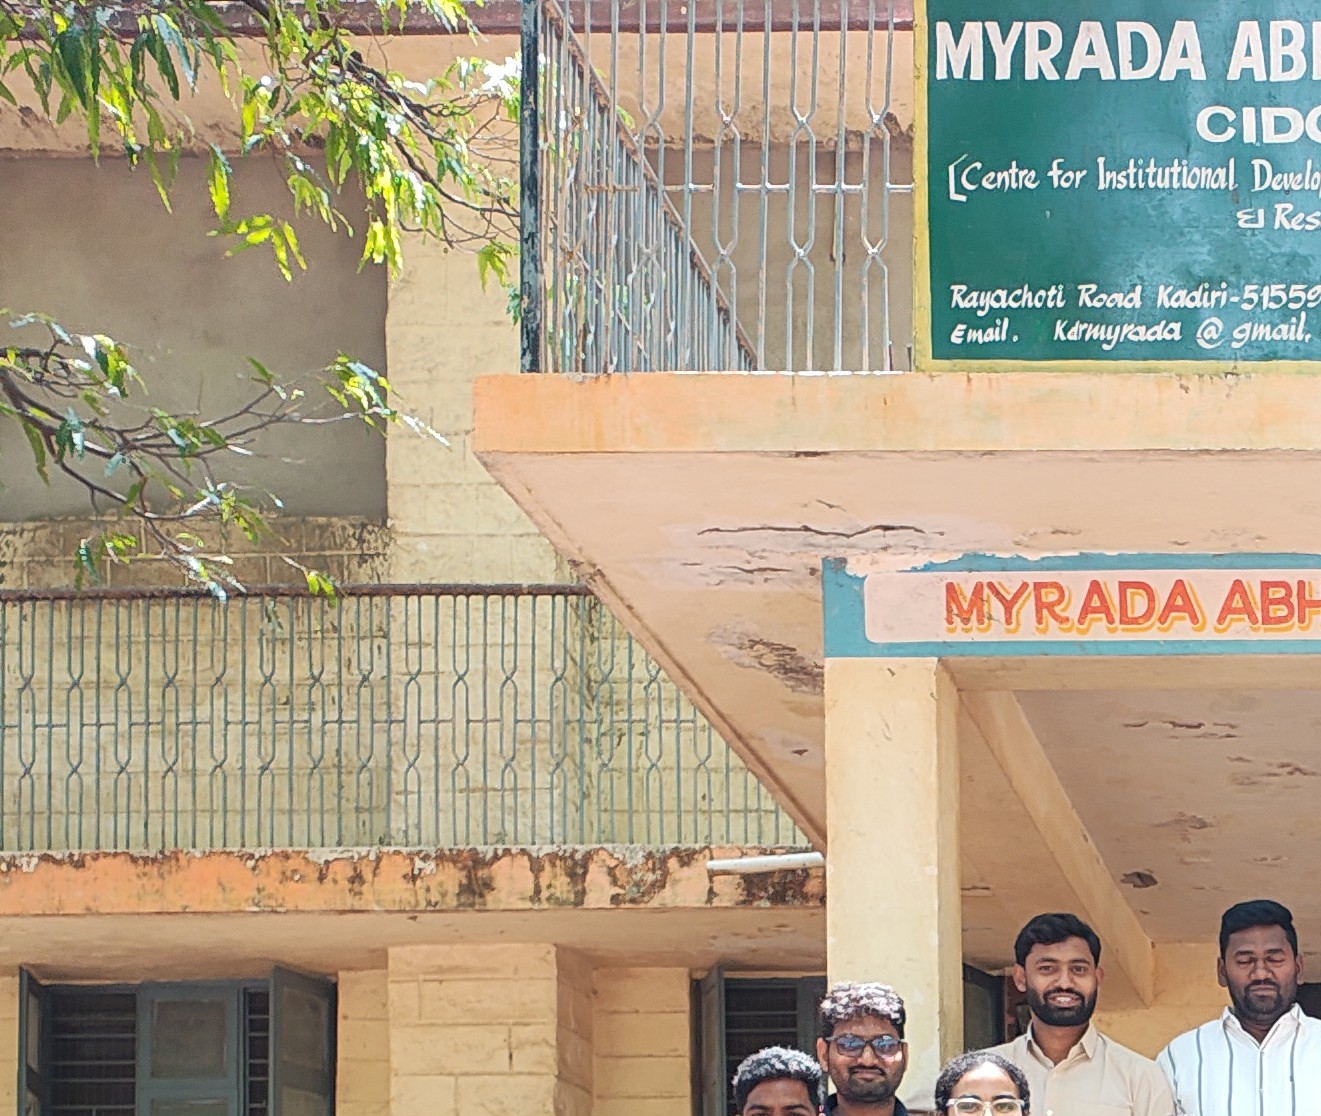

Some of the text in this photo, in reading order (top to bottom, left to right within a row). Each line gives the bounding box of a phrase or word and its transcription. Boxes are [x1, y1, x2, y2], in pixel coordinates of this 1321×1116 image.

[935, 20, 1207, 81] MYRADA
[1046, 158, 1088, 191] for
[1097, 156, 1239, 192] Institutional
[949, 283, 1066, 317] Rayachoti
[1077, 283, 1143, 310] Road
[944, 577, 1201, 634] MYRADA
